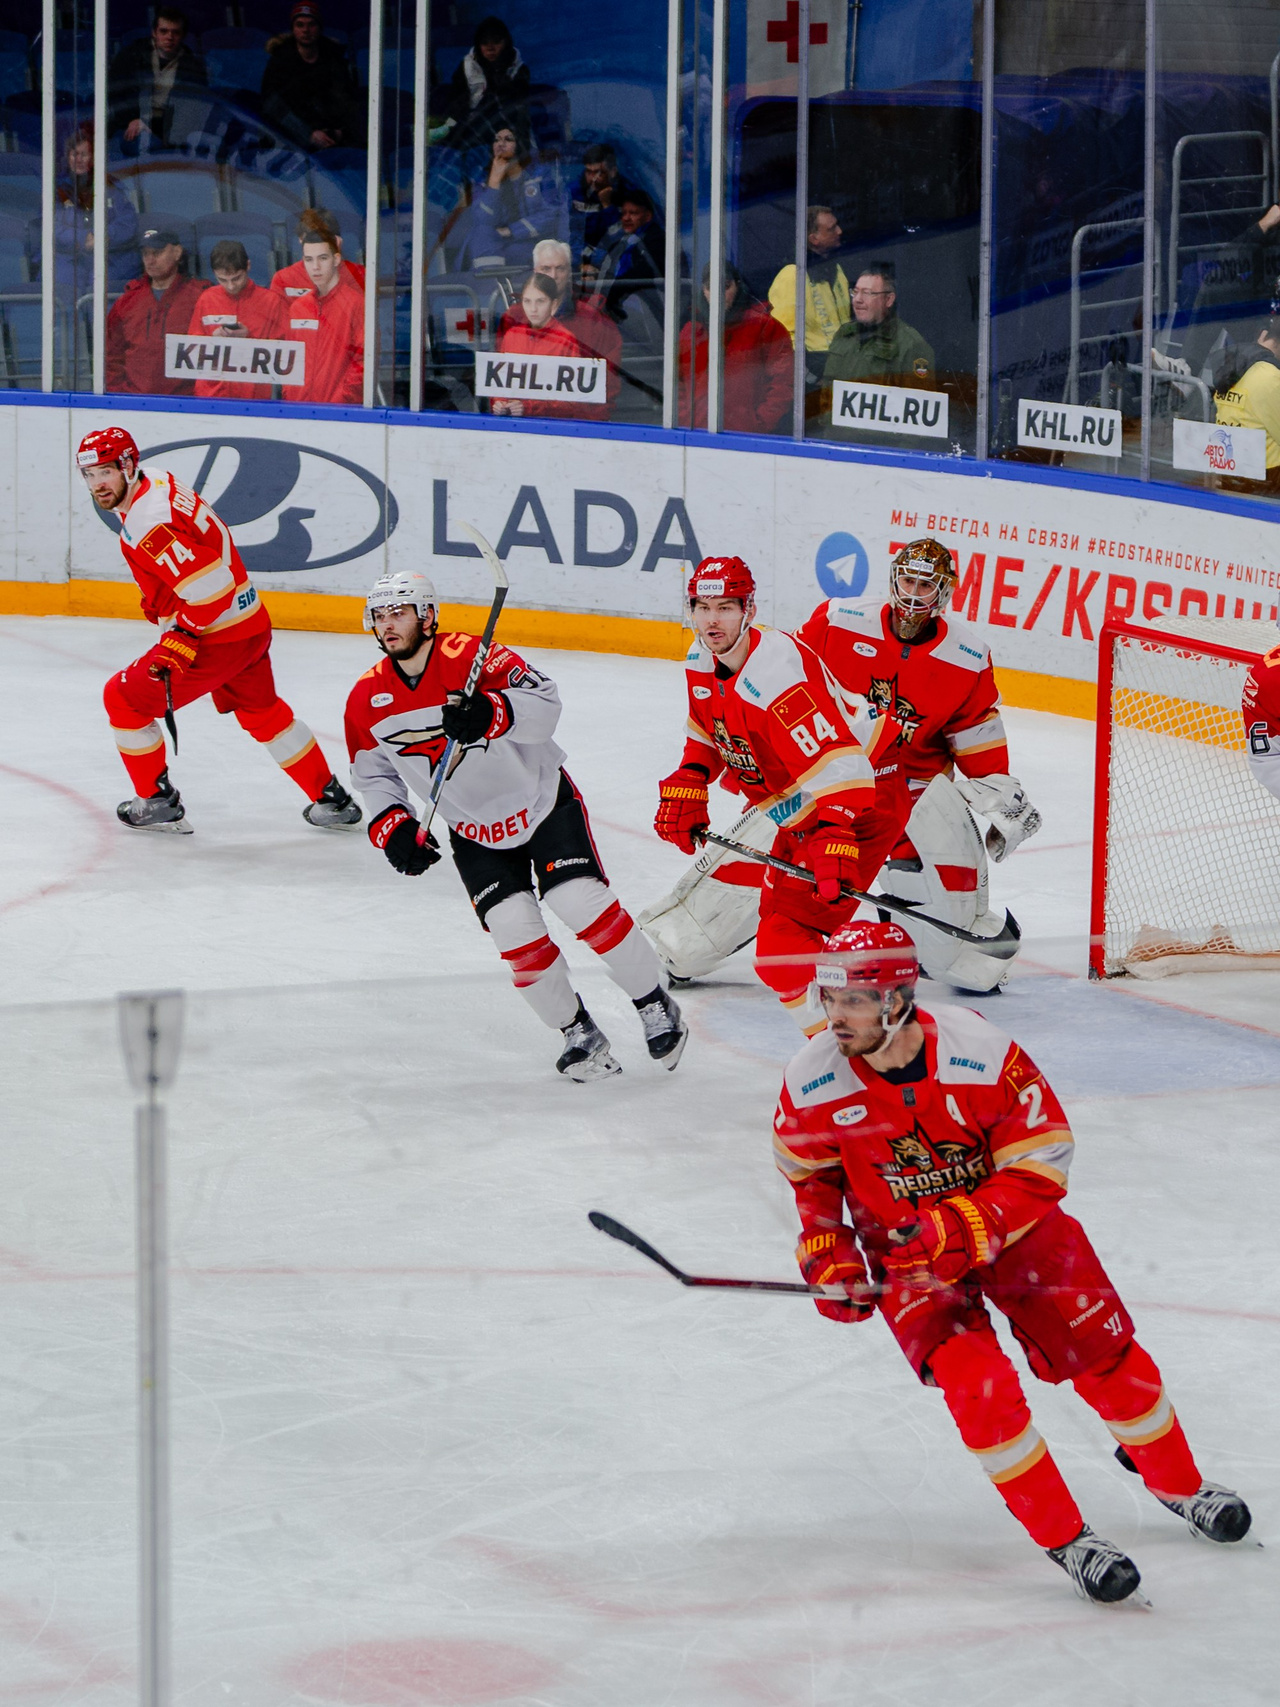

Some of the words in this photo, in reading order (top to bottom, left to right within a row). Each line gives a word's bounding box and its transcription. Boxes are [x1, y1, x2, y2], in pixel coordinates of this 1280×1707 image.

[174, 342, 297, 377] KHL.RU
[484, 361, 598, 394] KHL.RU
[839, 389, 941, 427] KHL.RU
[1024, 408, 1115, 447] KHL.RU
[1203, 444, 1225, 457] АВТО
[1209, 457, 1236, 471] РАДИО
[433, 479, 704, 573] LADA
[156, 540, 197, 578] 74
[890, 509, 918, 528] МЫ
[928, 514, 990, 538] ВСЕГДА
[999, 523, 1019, 543] НА
[1028, 528, 1080, 551] СВЯЗИ
[1088, 537, 1220, 577] #REDSTARHOCKEY
[699, 583, 723, 592] согаз
[838, 607, 865, 617] SIBUR
[162, 637, 198, 662] WARR
[959, 644, 984, 660] SIBUR
[463, 642, 488, 697] CCM
[743, 677, 761, 698] SIBUR
[789, 710, 840, 759] 84
[765, 792, 803, 826] BUR
[896, 968, 914, 976] CCM
[949, 1056, 987, 1073] SIBUR
[801, 1071, 836, 1096] SIBUR
[945, 1094, 967, 1126] A
[882, 1152, 989, 1201] REDSTAR
[916, 1180, 966, 1197] KUNLUN
